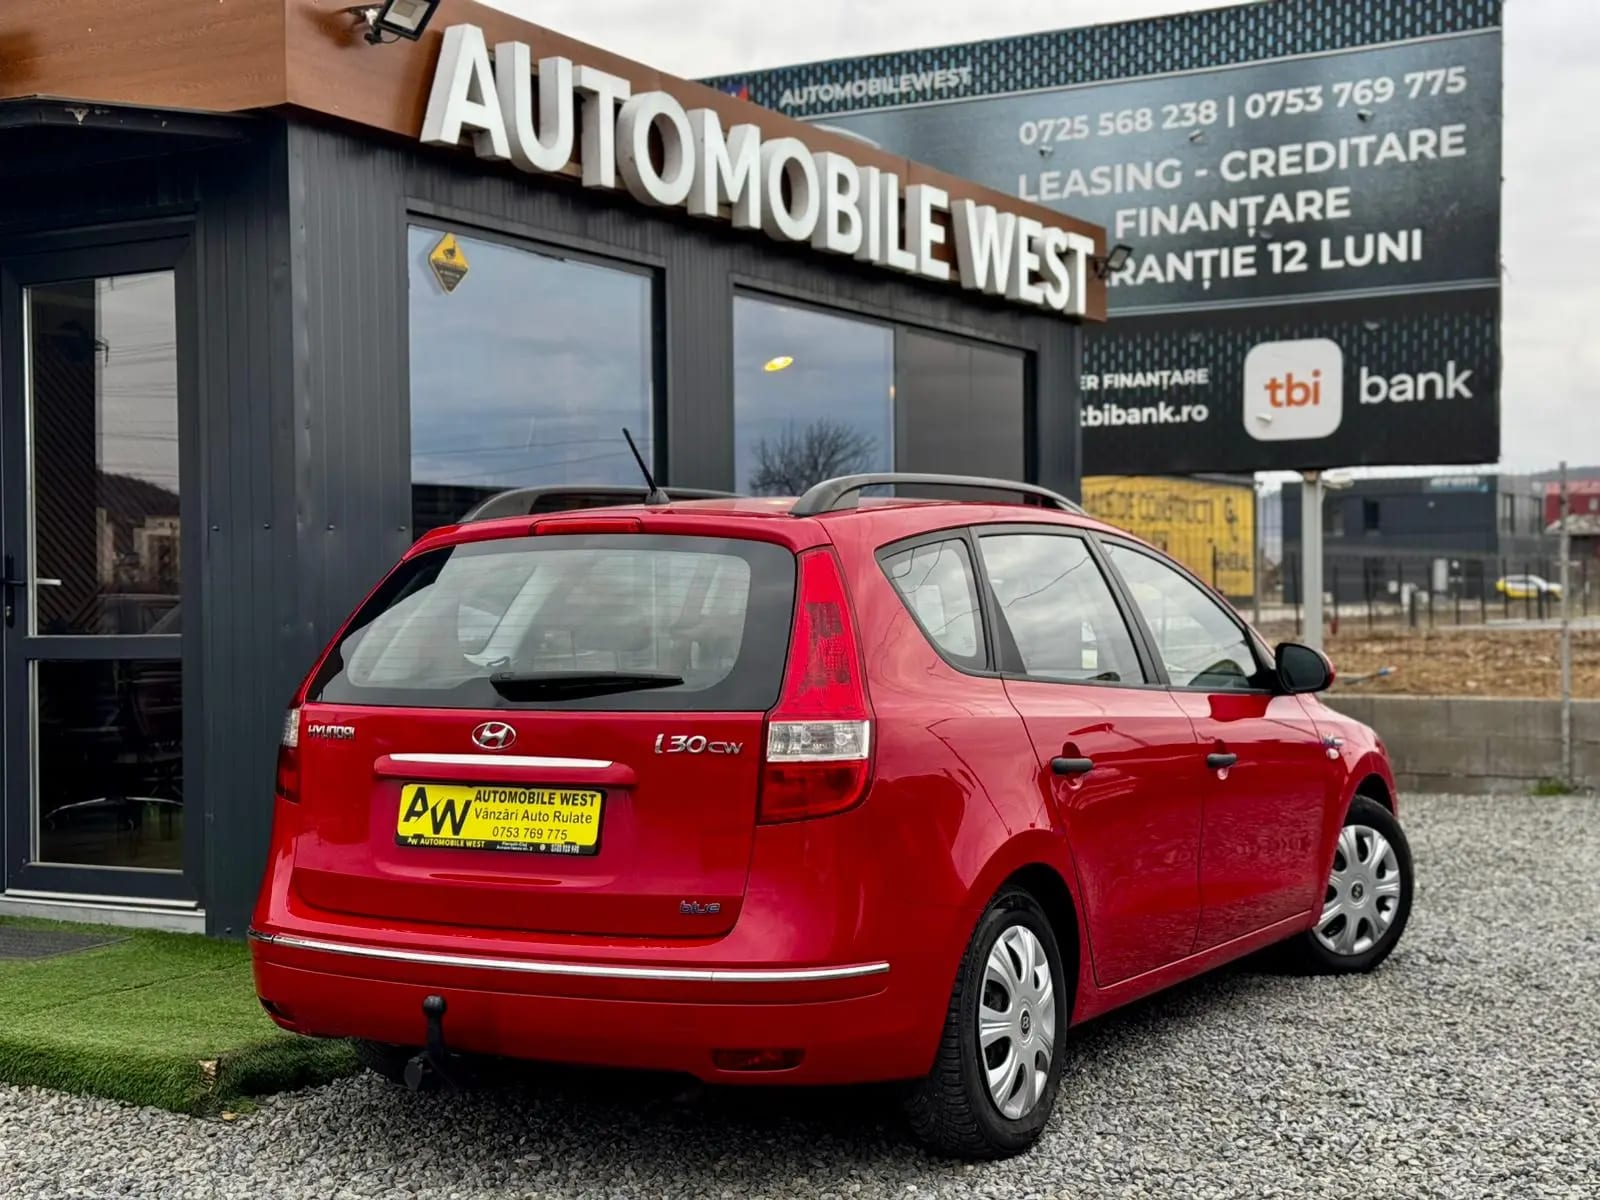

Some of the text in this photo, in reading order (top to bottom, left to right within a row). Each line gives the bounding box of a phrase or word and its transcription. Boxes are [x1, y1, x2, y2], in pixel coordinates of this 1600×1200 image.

[779, 66, 973, 107] AUTOMOBILEWEST
[1018, 115, 1089, 146] 0725
[1098, 108, 1153, 137] 568
[1162, 100, 1217, 130] 238
[1245, 86, 1323, 120] 0753
[1333, 77, 1394, 108] 769
[1405, 66, 1467, 98] 775
[420, 23, 1095, 316] AUTOMOBILE WEST
[1018, 157, 1183, 202] LEASING
[1219, 124, 1467, 184] CREDITARE
[1115, 187, 1351, 239] FINANȚARE
[1105, 228, 1423, 290] RANȚIE 12 LUNI
[1264, 360, 1473, 408] tbi bank
[474, 790, 597, 807] AUTOMOBILE WEST
[521, 810, 550, 823] Auto
[552, 810, 593, 824] Rulate
[420, 837, 465, 847] AUTOMOBILE
[466, 840, 485, 848] WEST
[492, 826, 568, 840] 0753 769 775
[680, 900, 720, 914] blue
